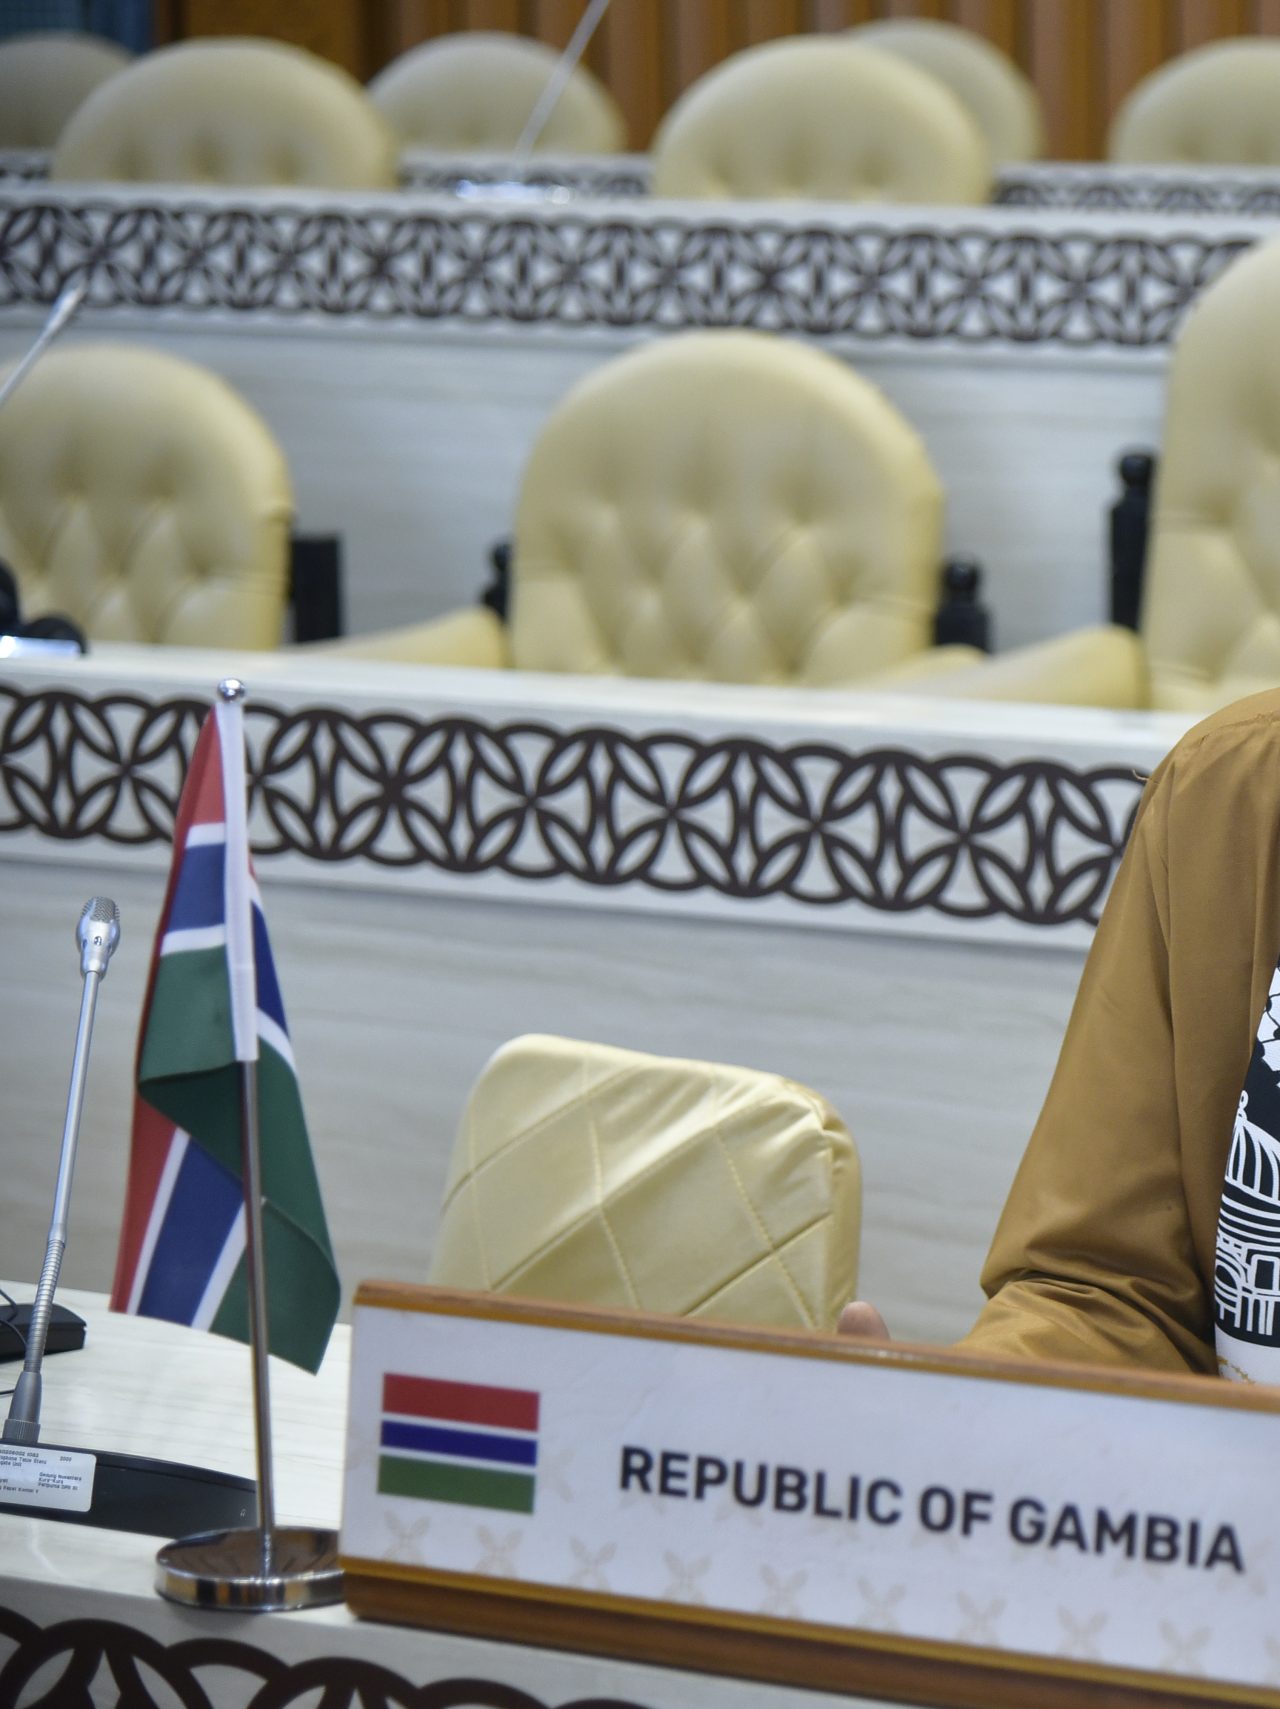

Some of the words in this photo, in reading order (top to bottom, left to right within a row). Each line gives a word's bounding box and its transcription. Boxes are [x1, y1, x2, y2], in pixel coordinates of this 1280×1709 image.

[619, 1445, 903, 1526] REPUBLIC
[919, 1486, 994, 1537] OF
[1008, 1498, 1245, 1573] GAMBIA
